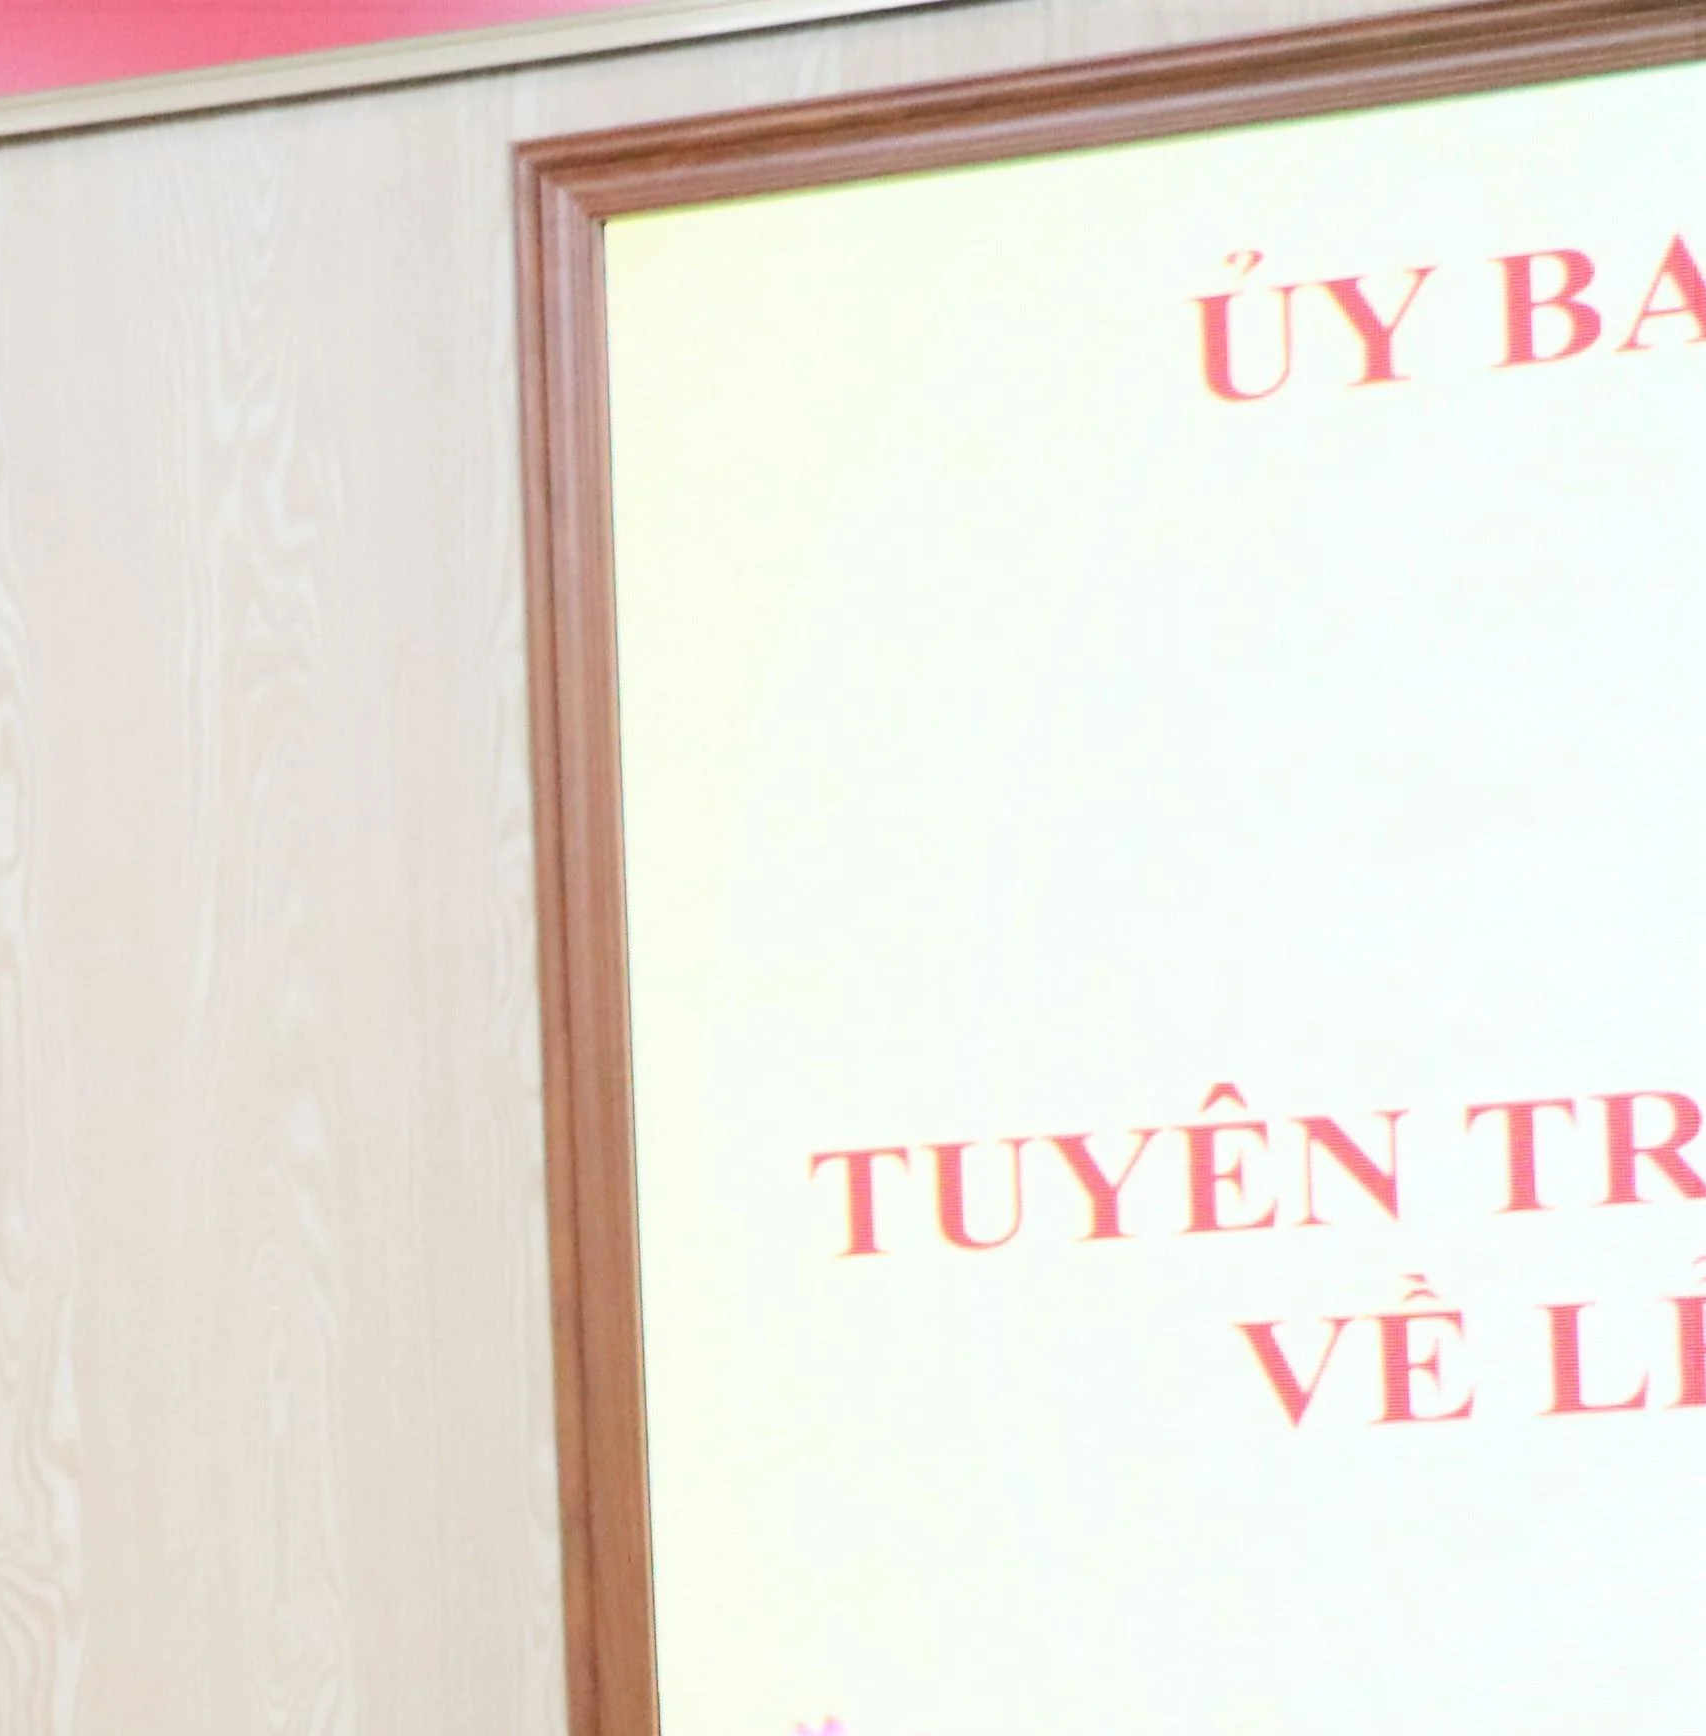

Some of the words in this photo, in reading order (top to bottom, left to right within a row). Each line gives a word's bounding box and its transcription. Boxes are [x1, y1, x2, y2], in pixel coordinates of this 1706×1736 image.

[1192, 250, 1437, 402] ỦY
[809, 1081, 1409, 1257] TUYÊN
[1233, 1273, 1474, 1429] VỀ
